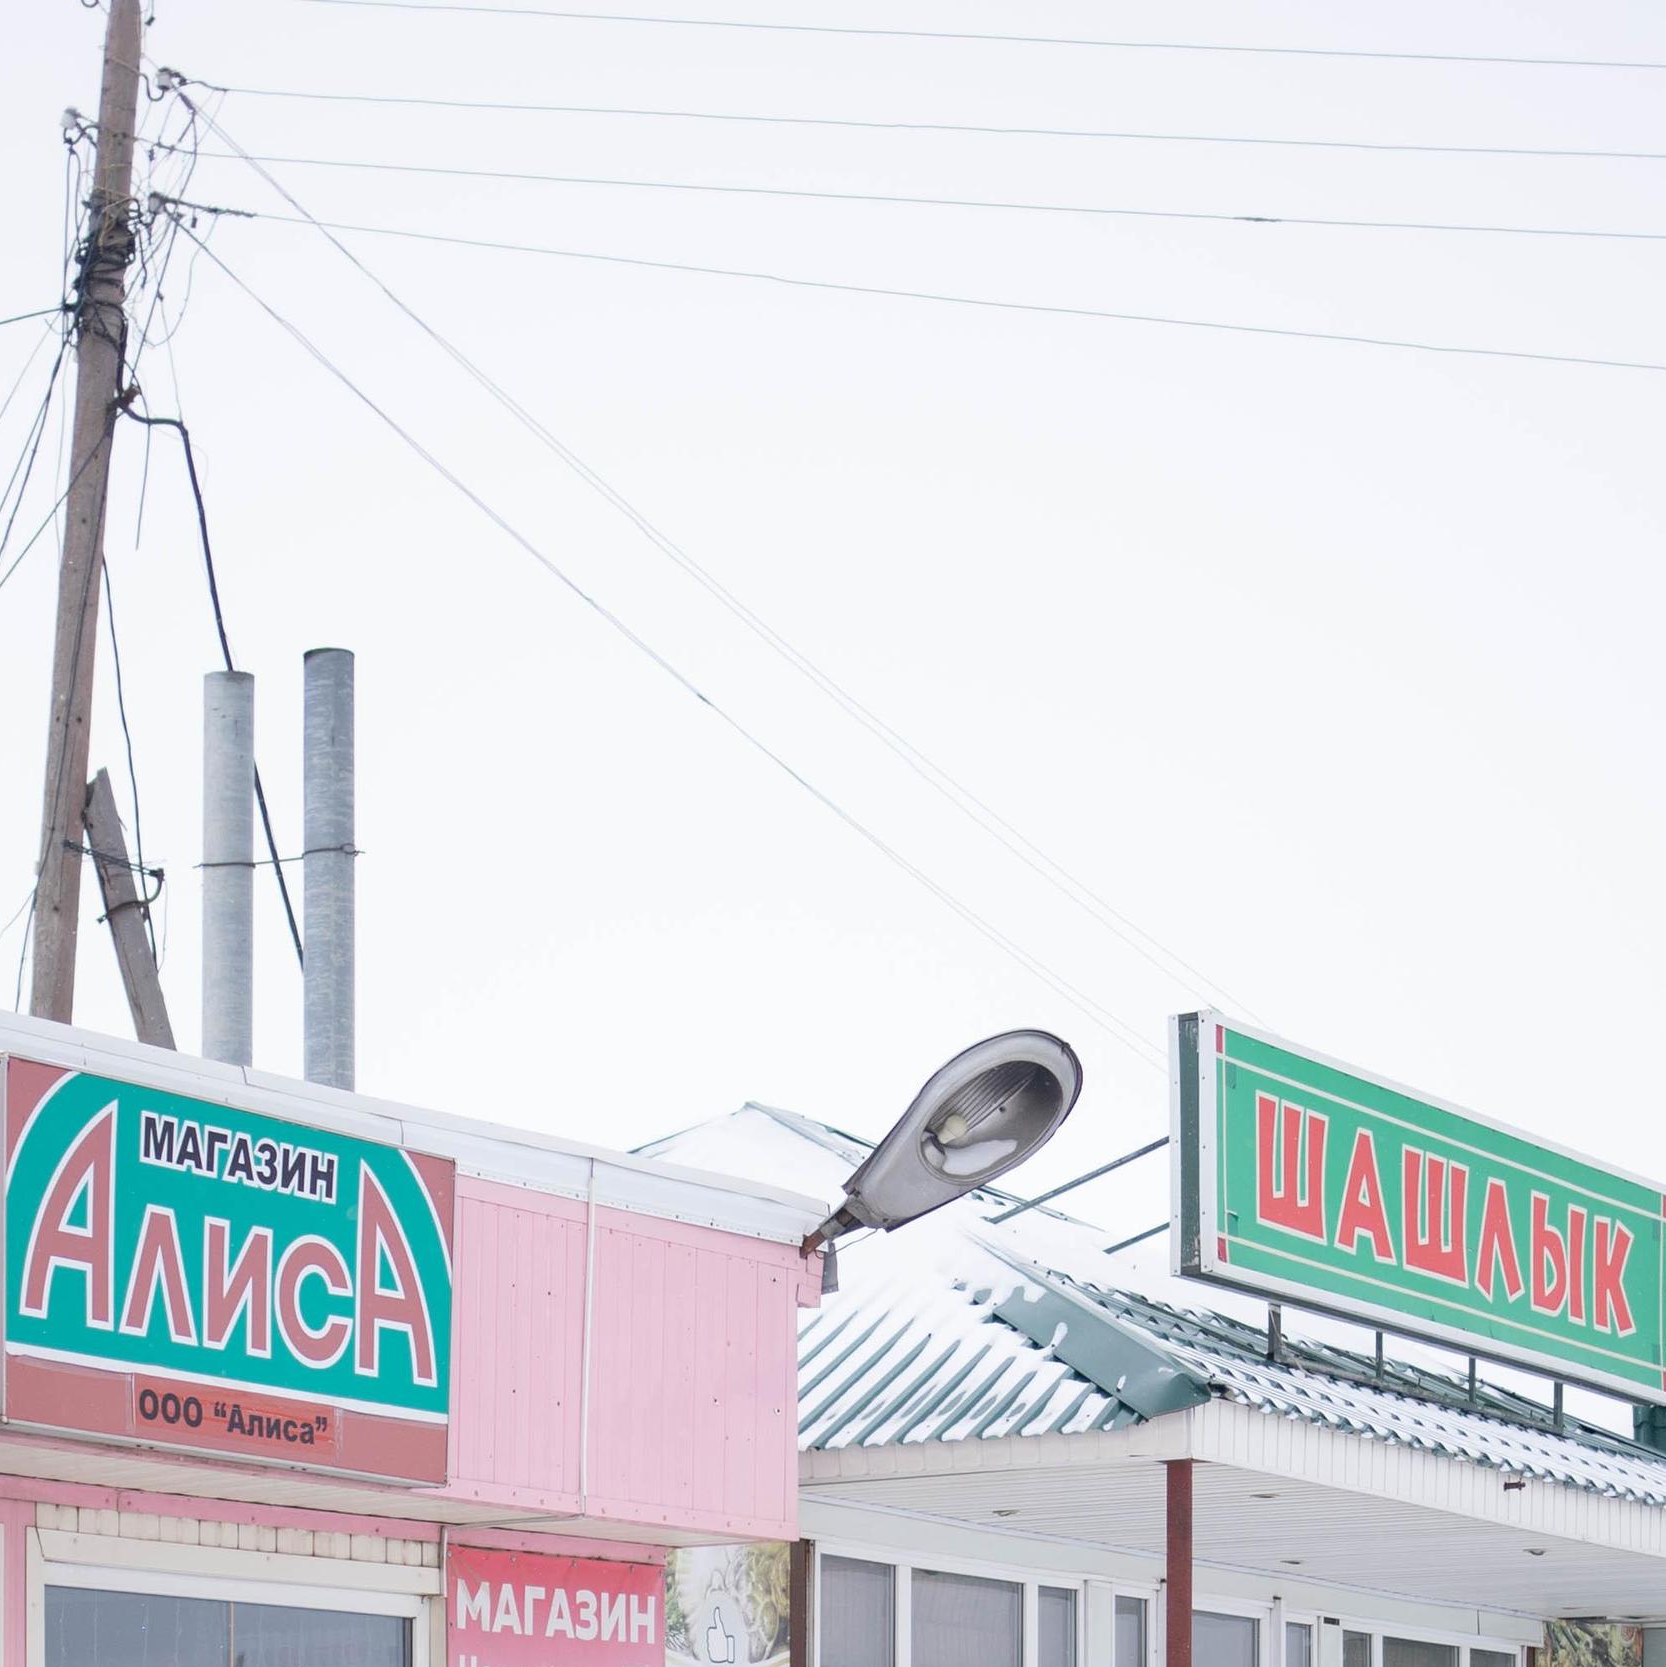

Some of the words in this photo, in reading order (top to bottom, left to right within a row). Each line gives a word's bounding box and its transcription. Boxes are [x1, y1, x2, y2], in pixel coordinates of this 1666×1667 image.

[141, 1112, 337, 1203] МАГАЗИН
[1255, 1089, 1635, 1337] ШАШЛЫК
[139, 1389, 203, 1428] ООО
[457, 1578, 656, 1644] МАГАЗИН
